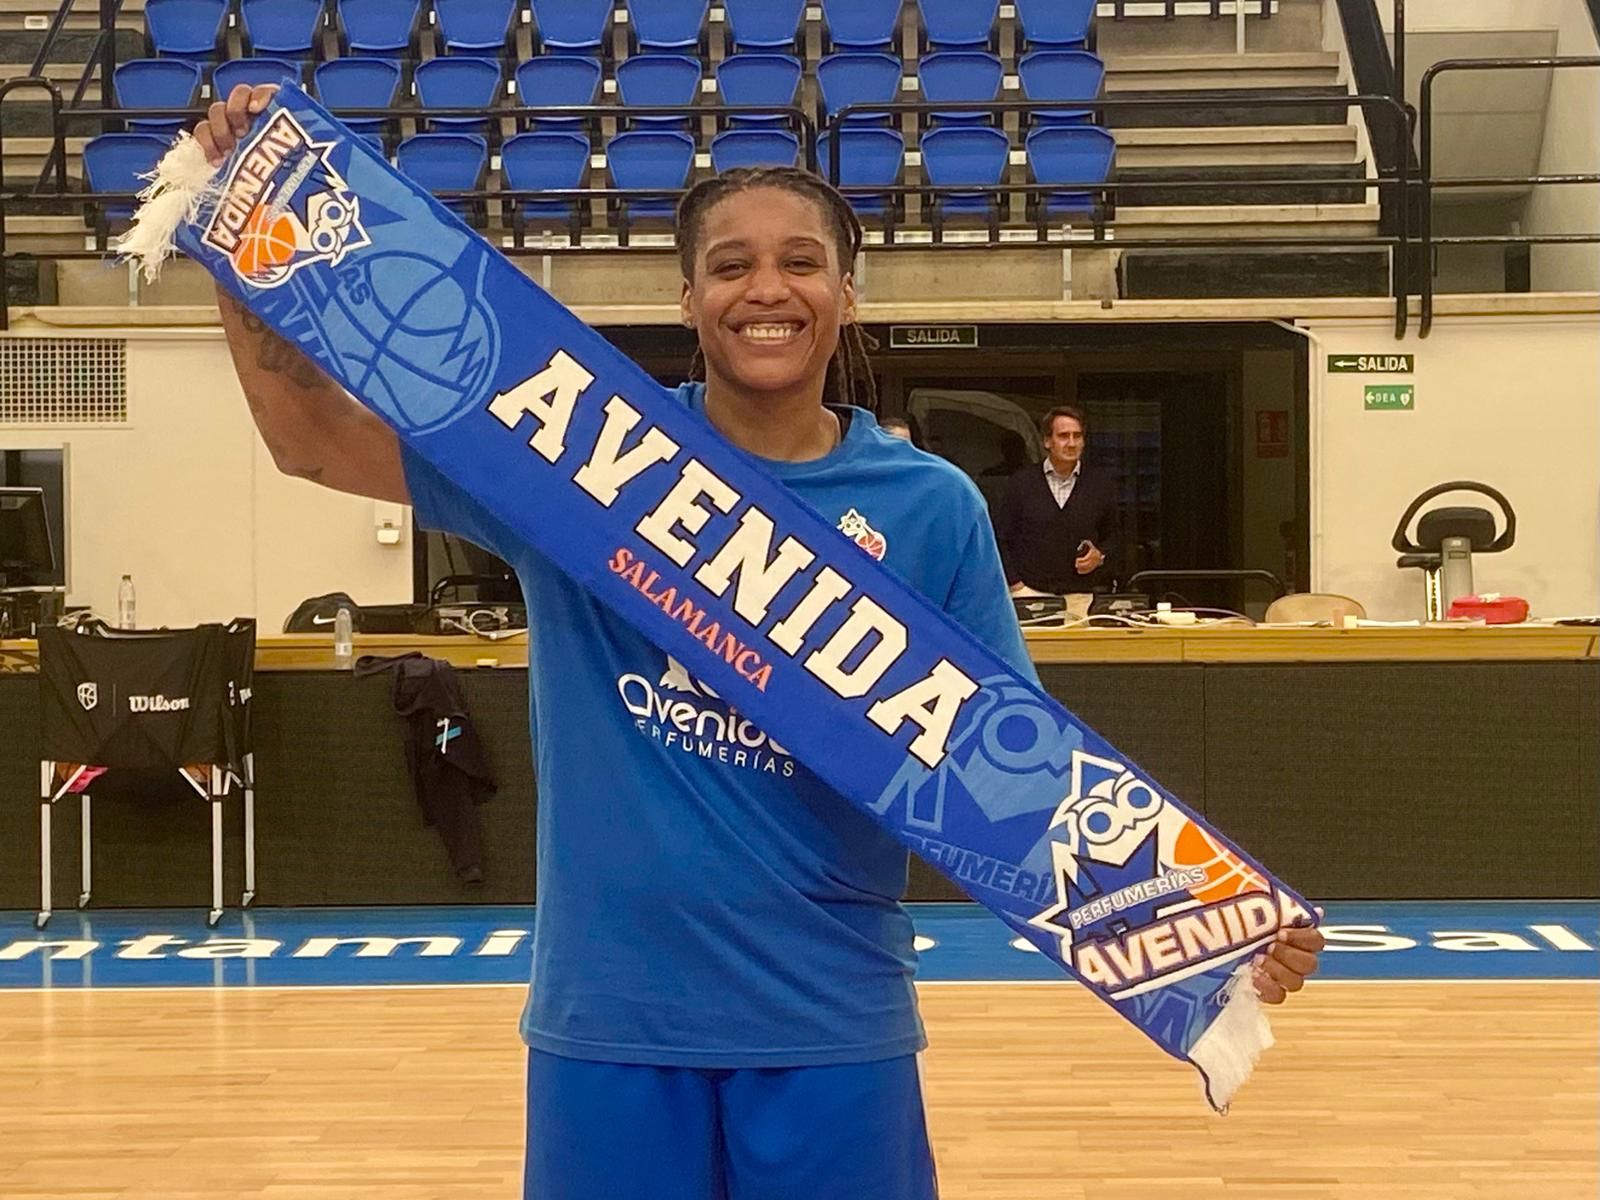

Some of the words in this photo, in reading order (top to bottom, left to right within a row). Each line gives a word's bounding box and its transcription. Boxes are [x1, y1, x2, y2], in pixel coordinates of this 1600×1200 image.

[211, 118, 301, 249] AVENIDA
[906, 329, 960, 343] SALIDA
[1357, 356, 1408, 371] SALIDA
[1375, 393, 1396, 403] DEA
[487, 348, 982, 770] AVENIDA
[607, 546, 773, 693] SALAMANCA
[128, 695, 190, 713] Wilson
[634, 718, 795, 778] ERFUMERÍAS
